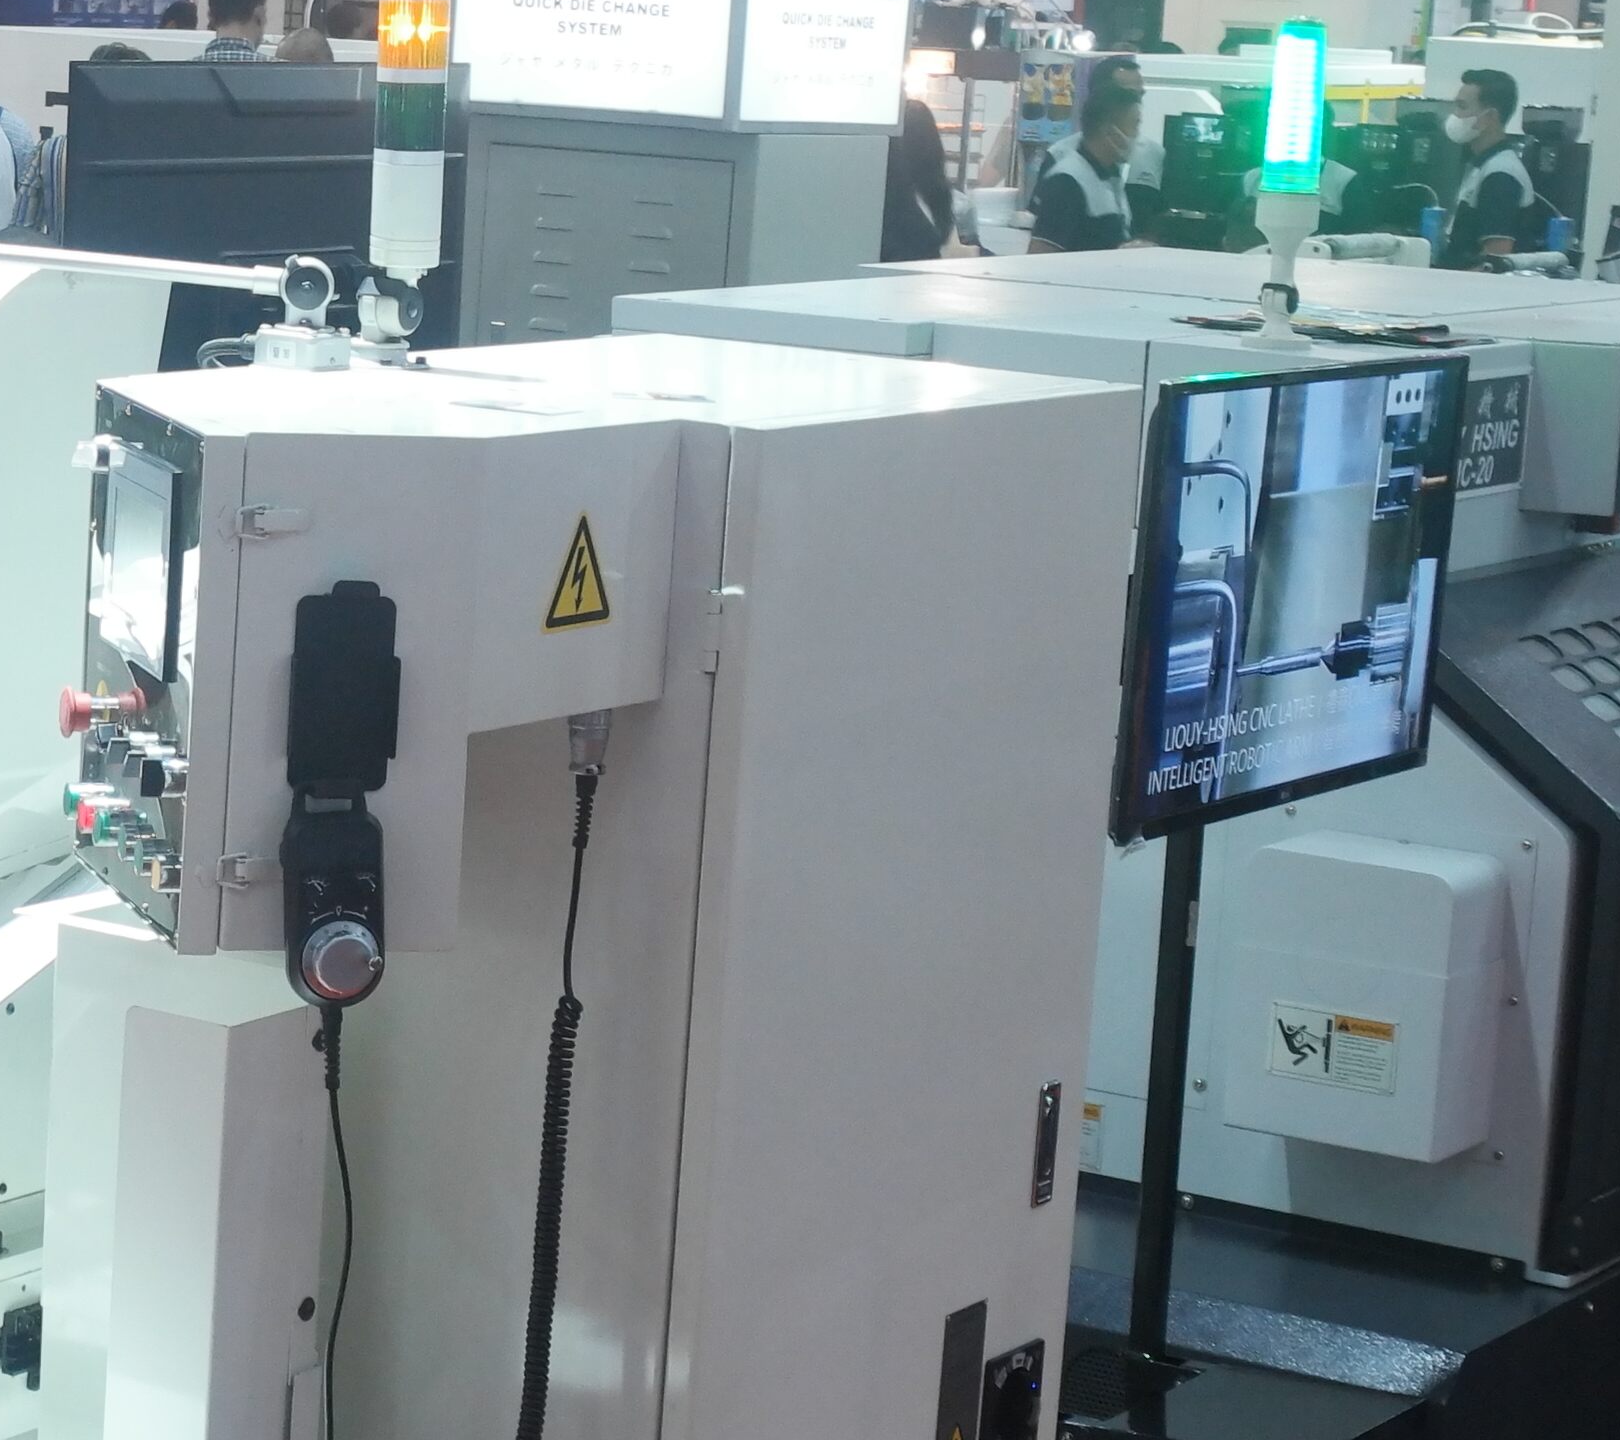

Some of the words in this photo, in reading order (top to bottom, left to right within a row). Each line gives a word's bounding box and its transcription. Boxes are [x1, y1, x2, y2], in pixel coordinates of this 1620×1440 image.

[602, 1, 671, 18] CHANGE
[556, 20, 623, 36] SYSTEM
[781, 11, 813, 25] QUICK
[817, 14, 833, 27] DIE
[836, 15, 876, 29] CHANGE
[808, 36, 847, 50] SYSTEM
[1470, 418, 1520, 455] HSING
[1163, 709, 1249, 754] LIOUY-HSING
[1249, 705, 1276, 732] CNC
[1146, 753, 1229, 796] INTELLIGENT
